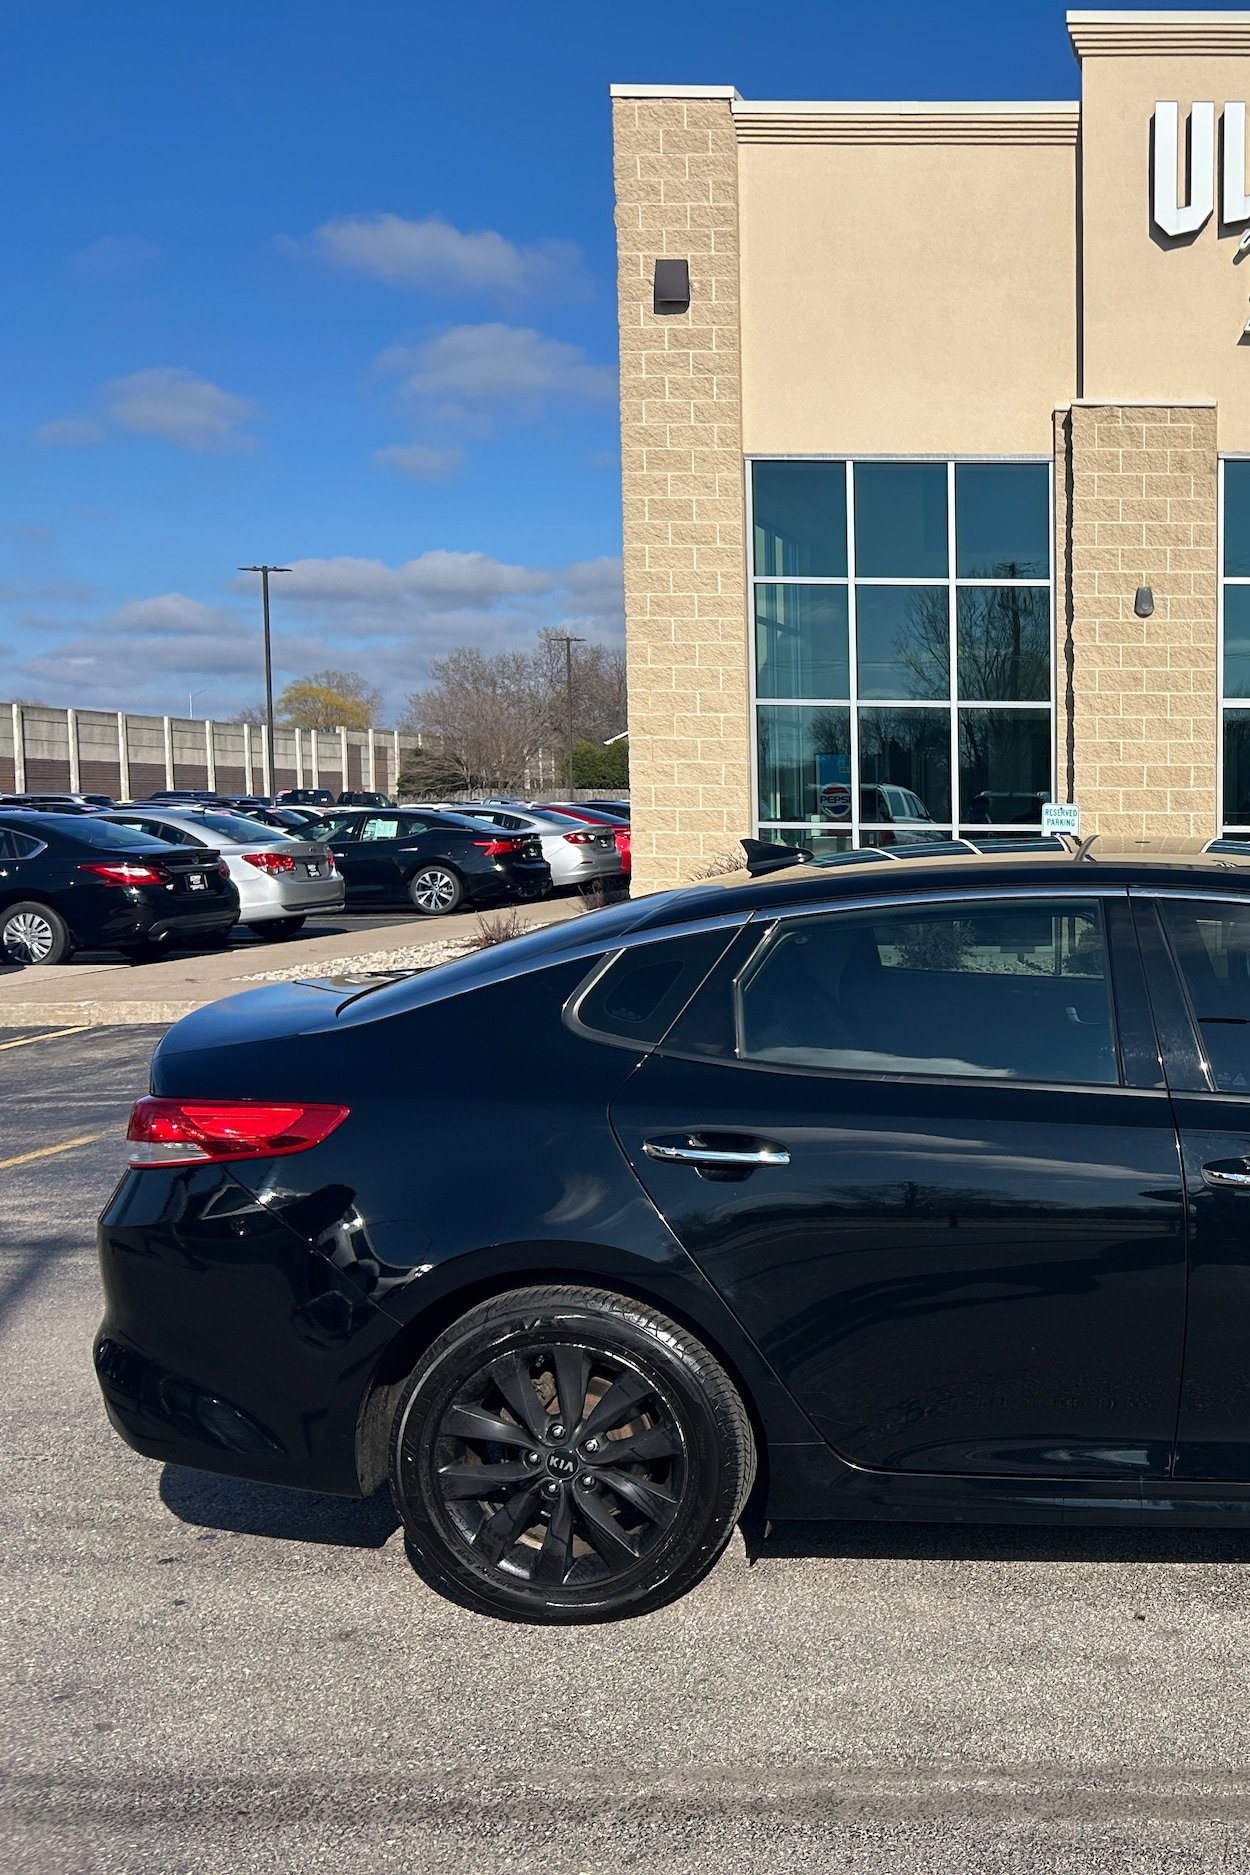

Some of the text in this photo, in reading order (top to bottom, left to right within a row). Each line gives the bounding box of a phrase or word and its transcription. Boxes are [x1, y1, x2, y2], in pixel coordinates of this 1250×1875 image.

[820, 795, 851, 804] PEPSI
[1044, 809, 1078, 817] RESERVED
[1046, 818, 1076, 827] PARKING
[549, 1455, 574, 1472] KIA
